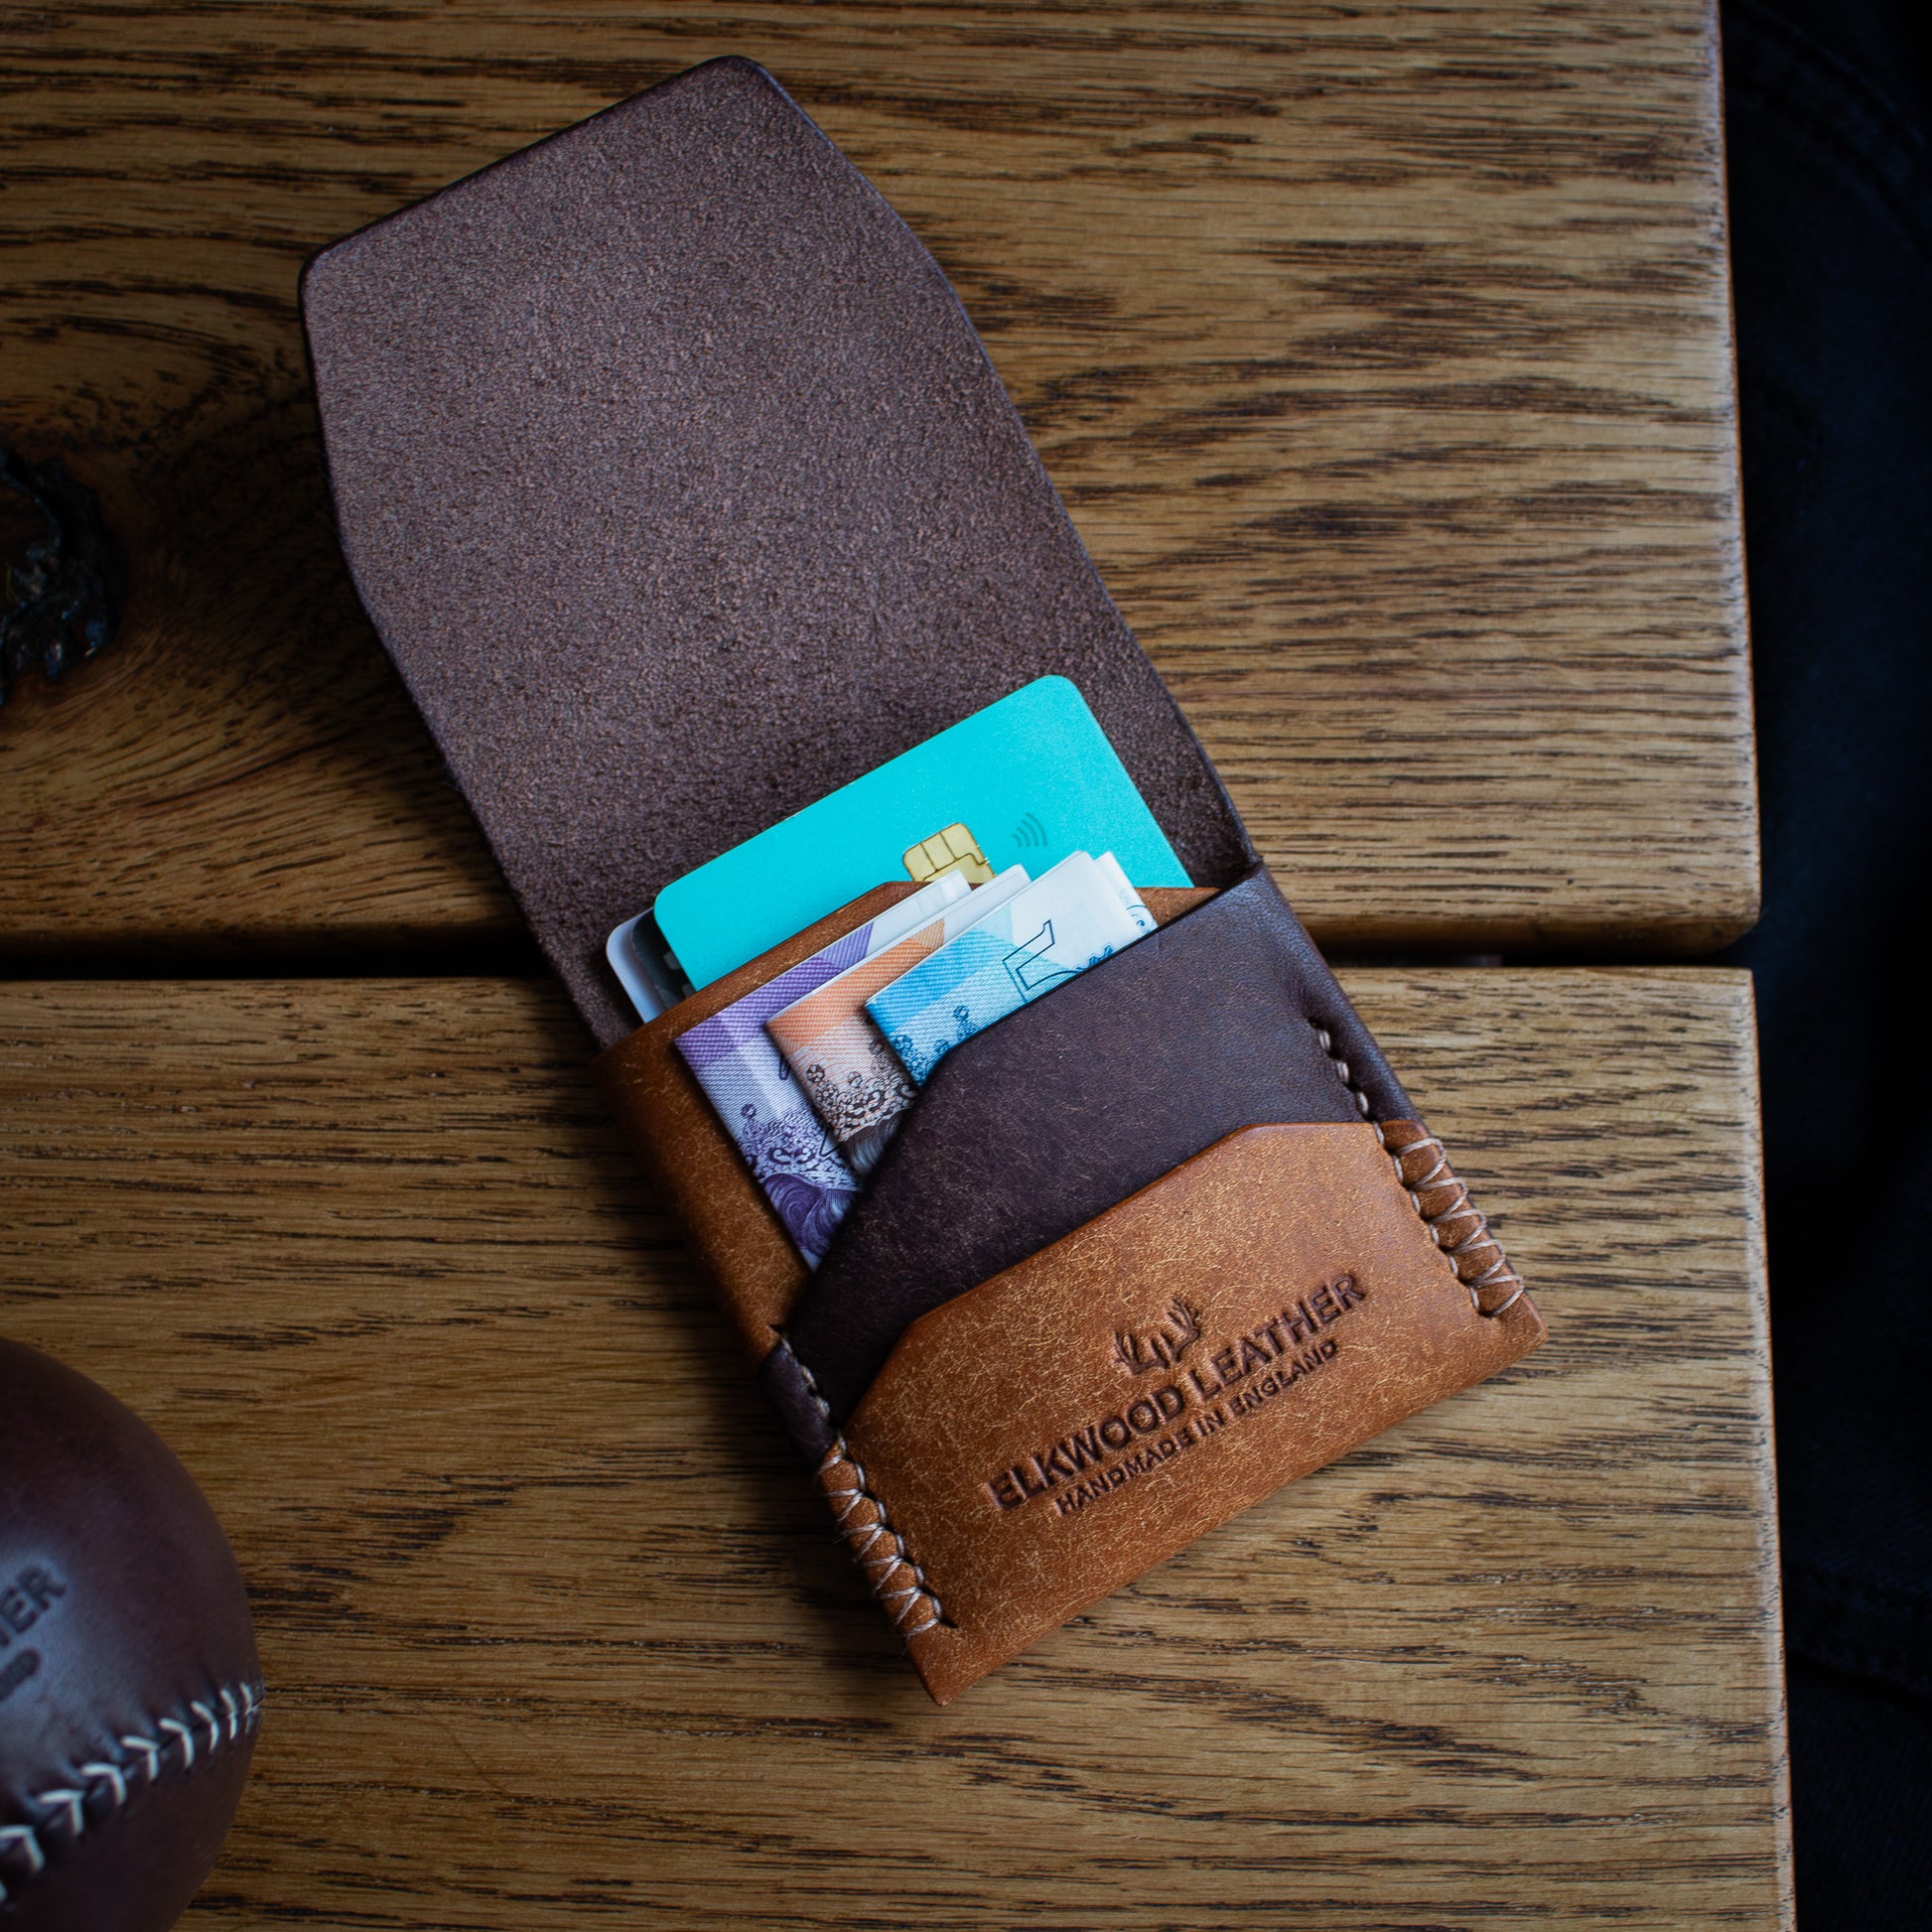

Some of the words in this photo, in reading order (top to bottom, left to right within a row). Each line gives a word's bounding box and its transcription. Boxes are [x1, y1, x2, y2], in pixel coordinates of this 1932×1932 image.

[990, 1384, 1185, 1511] ELKWOOD
[1189, 1274, 1367, 1402] LEATHER
[1055, 1431, 1193, 1516] HANDMADE
[1196, 1408, 1225, 1440] IN
[1230, 1339, 1340, 1418] ENGLAND
[0, 1567, 67, 1648] ER
